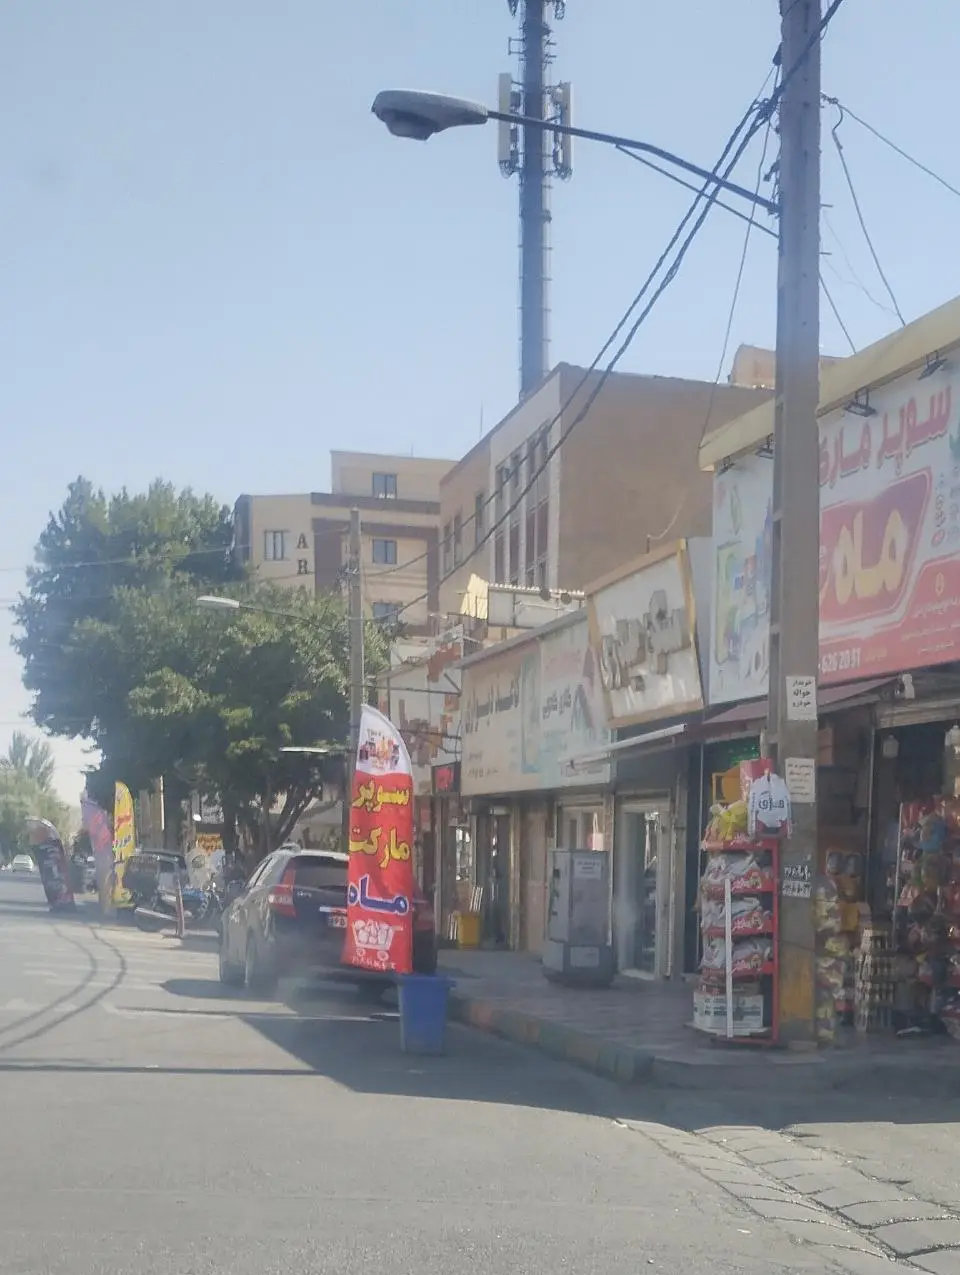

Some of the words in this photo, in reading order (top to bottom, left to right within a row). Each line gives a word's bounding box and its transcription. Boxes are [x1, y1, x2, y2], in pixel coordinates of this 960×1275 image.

[833, 507, 909, 606] ماه
[352, 780, 410, 813] سوپر
[348, 826, 410, 870] مارکت
[347, 873, 409, 916] ماه
